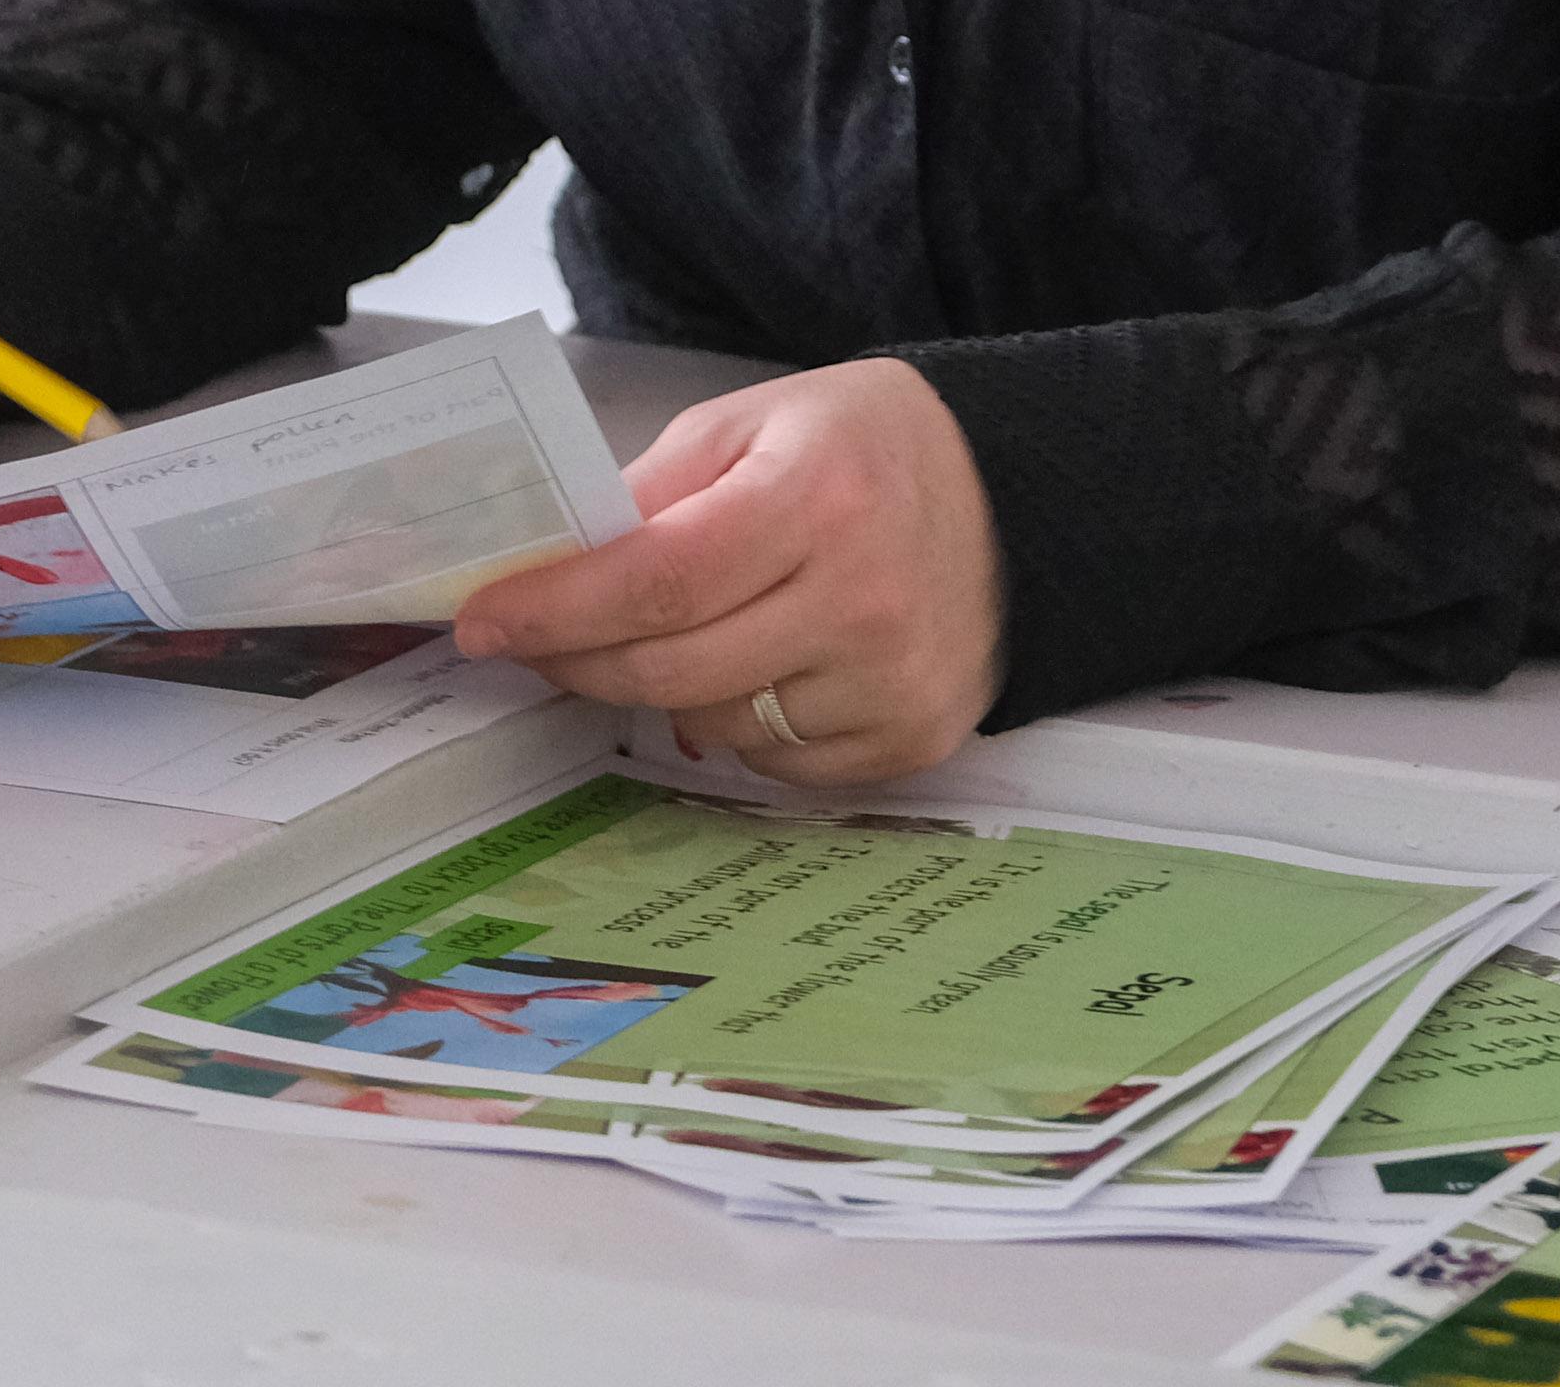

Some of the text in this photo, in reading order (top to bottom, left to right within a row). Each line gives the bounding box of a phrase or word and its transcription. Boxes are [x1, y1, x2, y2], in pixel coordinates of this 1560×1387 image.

[477, 838, 520, 857] go
[507, 825, 554, 843] to
[432, 850, 507, 883] back
[402, 882, 449, 904] to
[597, 837, 797, 932] pollination process.
[651, 847, 871, 949] It is not part of the
[784, 855, 966, 946] protects the bud.
[293, 912, 381, 951] Parts
[448, 922, 515, 951] sepal
[902, 880, 1170, 1016] The sepal is usually green.
[265, 948, 307, 968] of
[715, 863, 1042, 1034] It is the part of the flower that
[245, 962, 277, 973] a
[1083, 972, 1195, 1017] Sepal
[1450, 996, 1537, 1010] the
